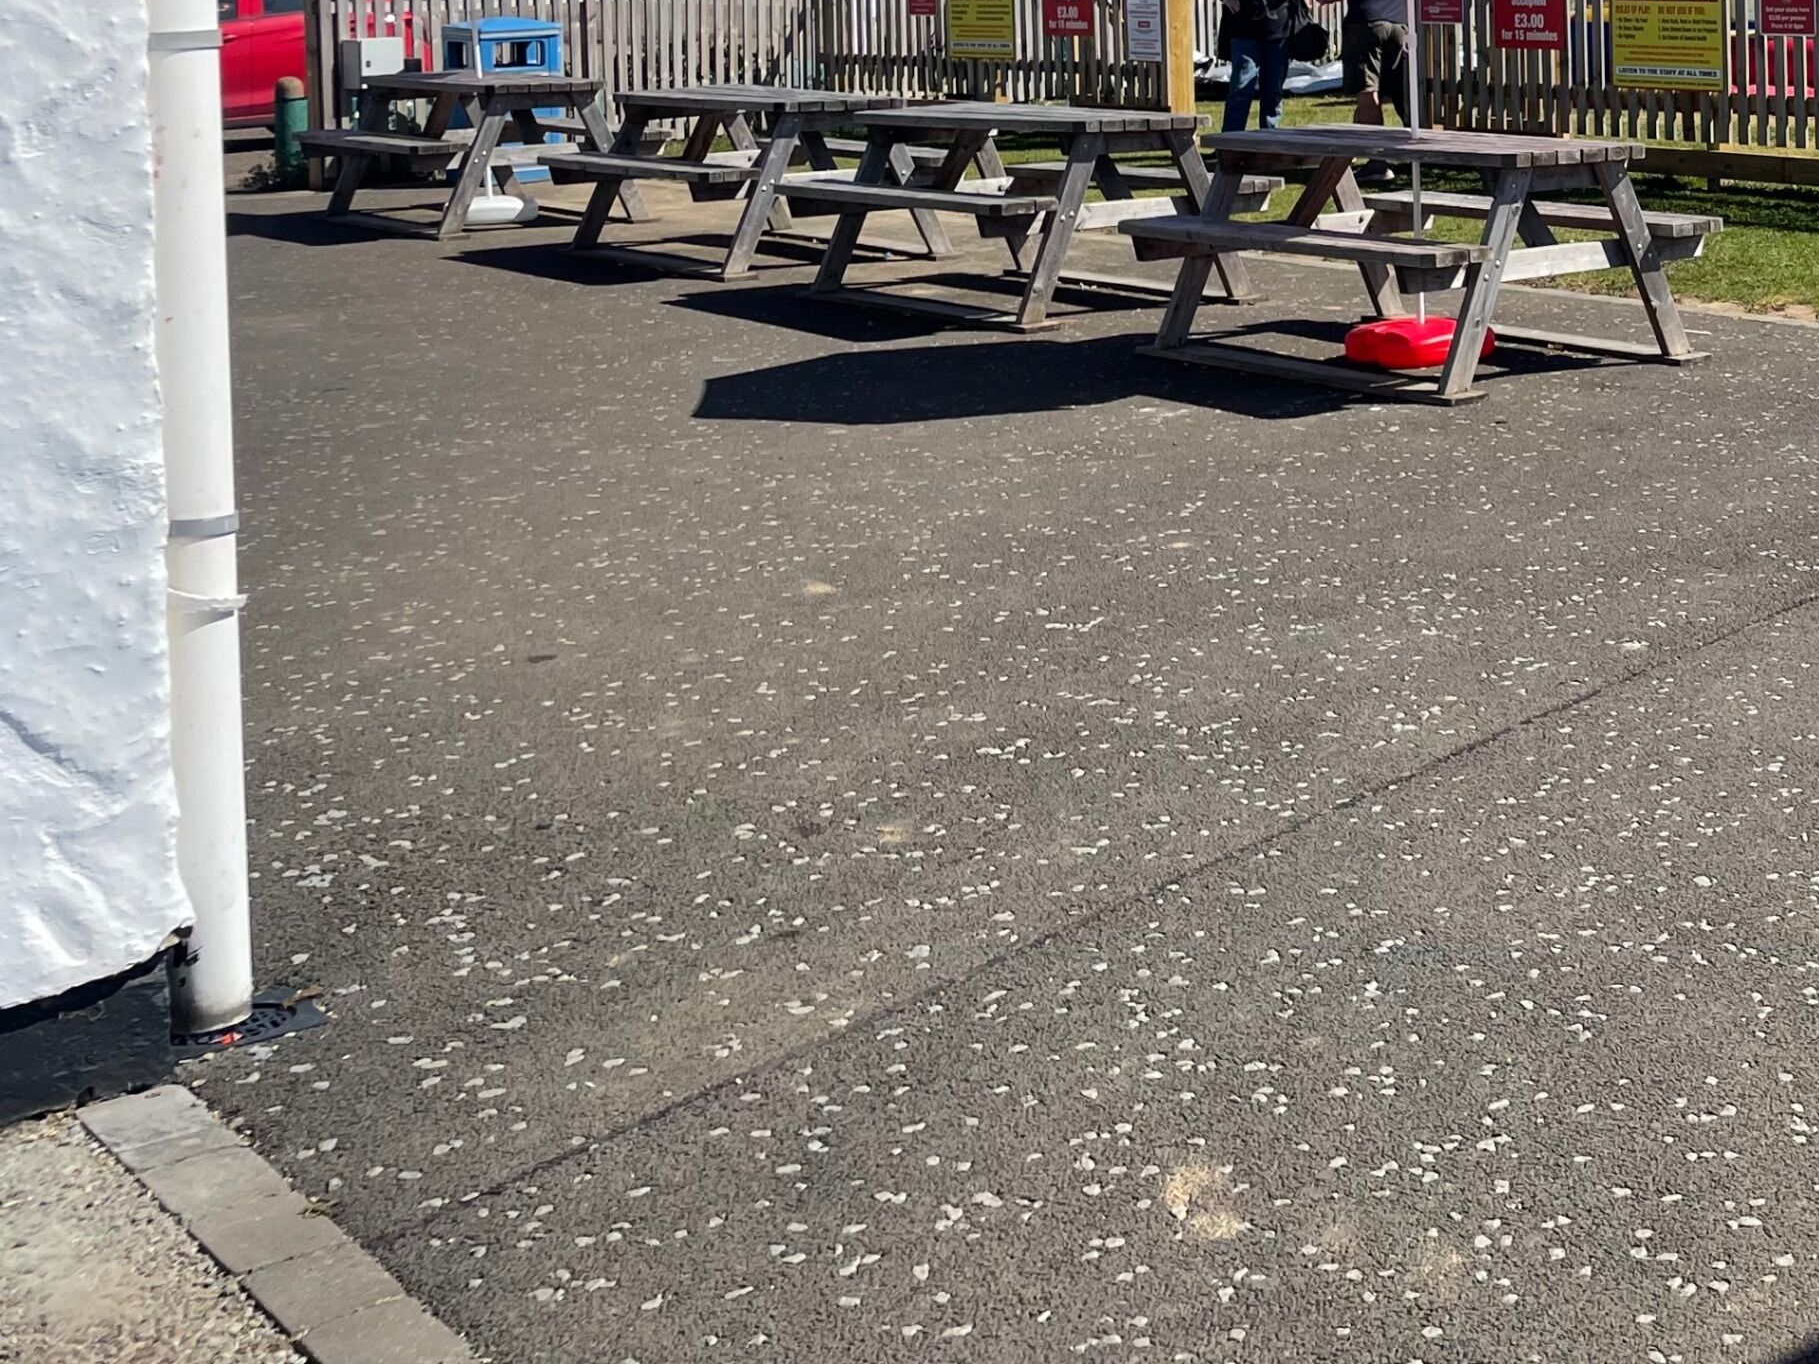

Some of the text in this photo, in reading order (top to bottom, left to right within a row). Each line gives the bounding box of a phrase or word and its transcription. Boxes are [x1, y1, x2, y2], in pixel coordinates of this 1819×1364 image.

[1057, 6, 1078, 19] £3.00
[1048, 19, 1088, 29] for 15 minutes
[1514, 14, 1544, 28] £3.00
[1502, 29, 1558, 41] for 15 minutes
